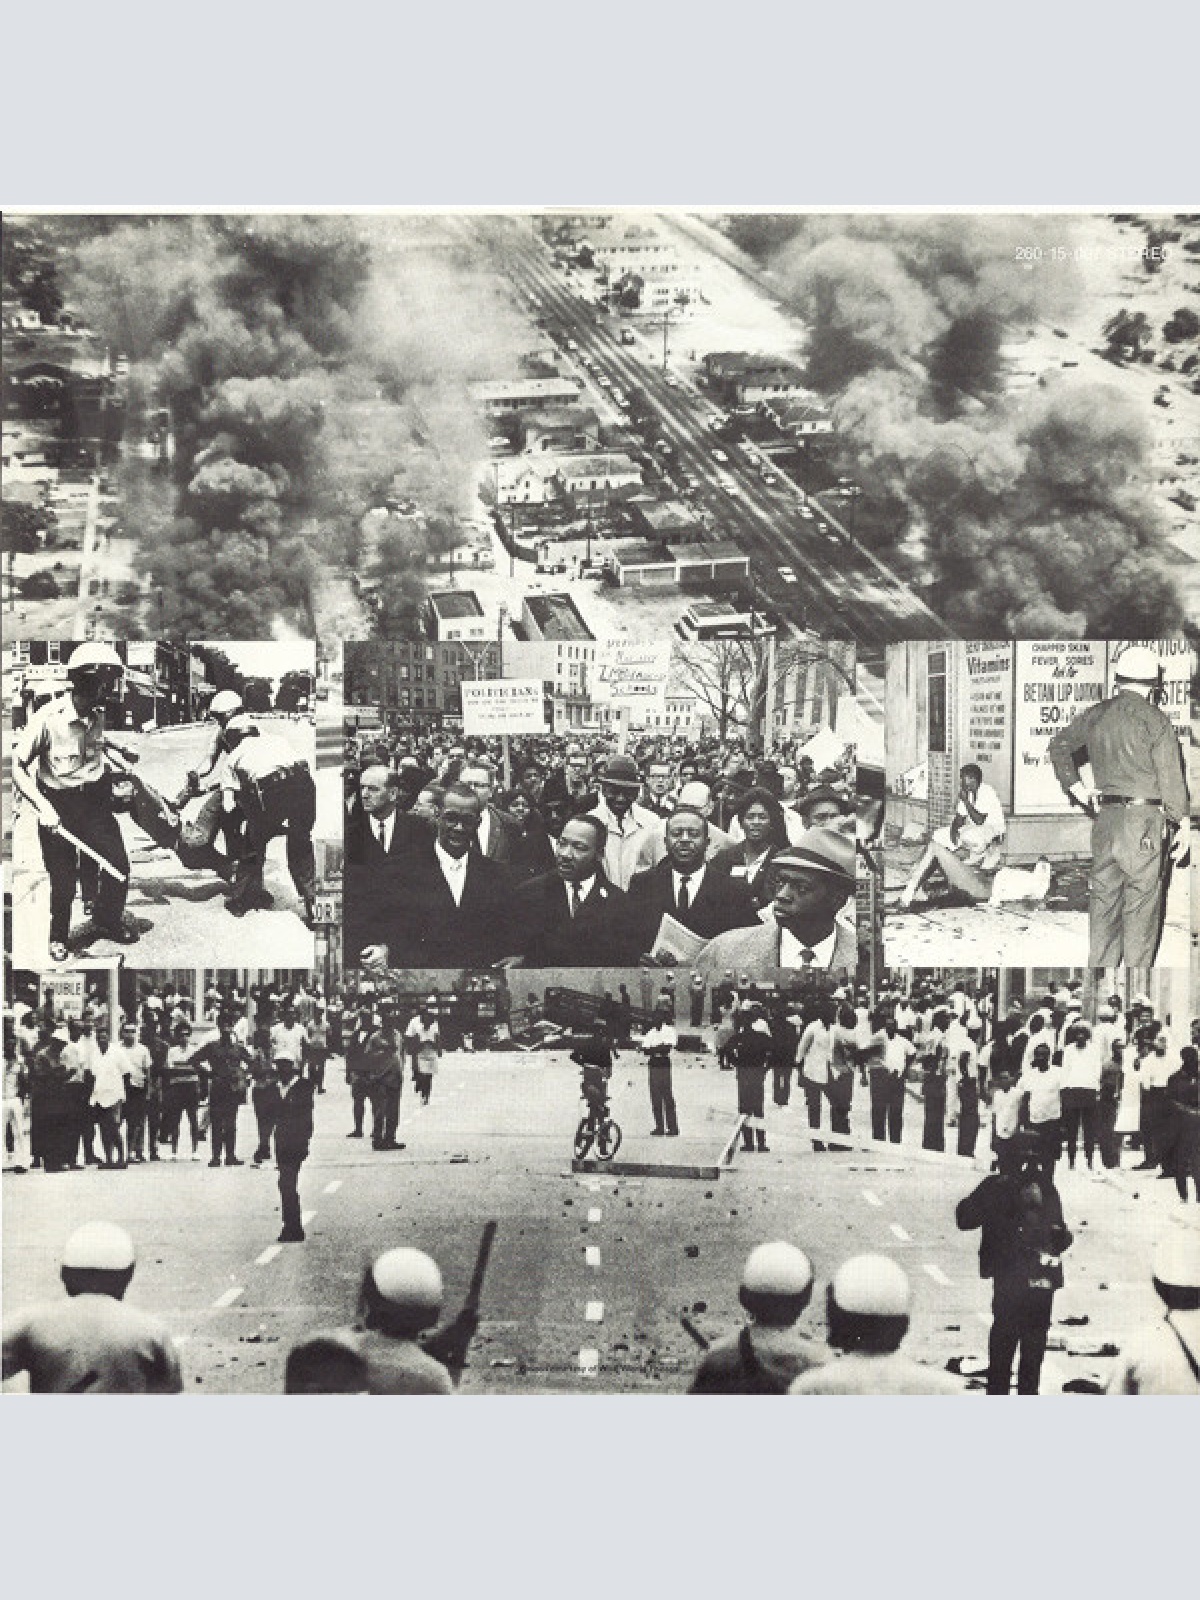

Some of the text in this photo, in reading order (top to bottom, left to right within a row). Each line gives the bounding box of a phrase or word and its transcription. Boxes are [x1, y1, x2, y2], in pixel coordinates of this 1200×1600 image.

[1067, 643, 1090, 652] SKIN
[967, 654, 1010, 676] Vitamins
[1065, 655, 1094, 666] SORES
[1023, 683, 1055, 702] BETAN
[1057, 683, 1073, 702] LIP
